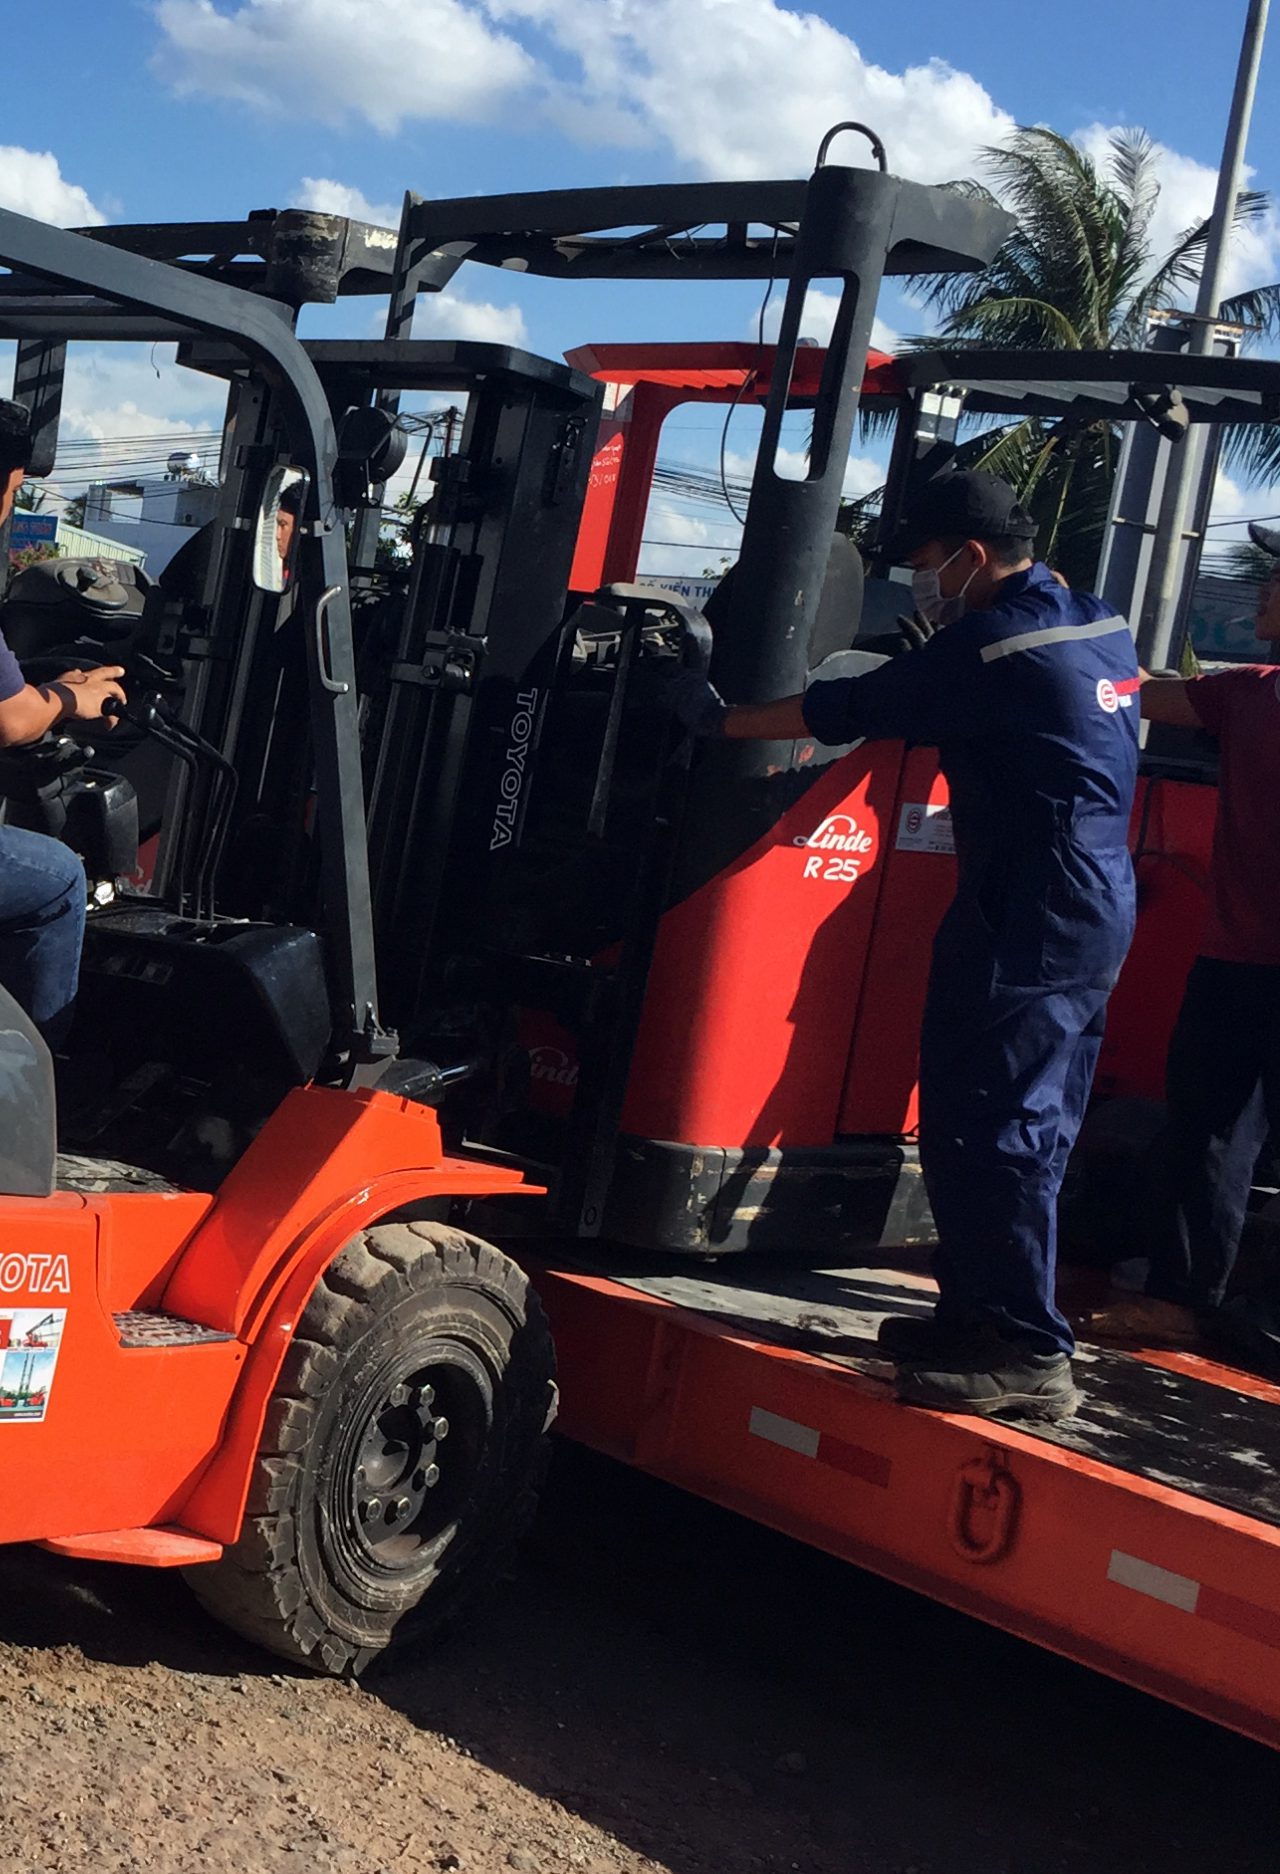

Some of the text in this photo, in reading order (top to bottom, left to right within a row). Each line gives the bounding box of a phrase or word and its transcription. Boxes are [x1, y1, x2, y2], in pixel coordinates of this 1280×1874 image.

[489, 687, 539, 851] TOYOTA
[793, 814, 873, 853] Linde
[803, 855, 862, 882] R 25
